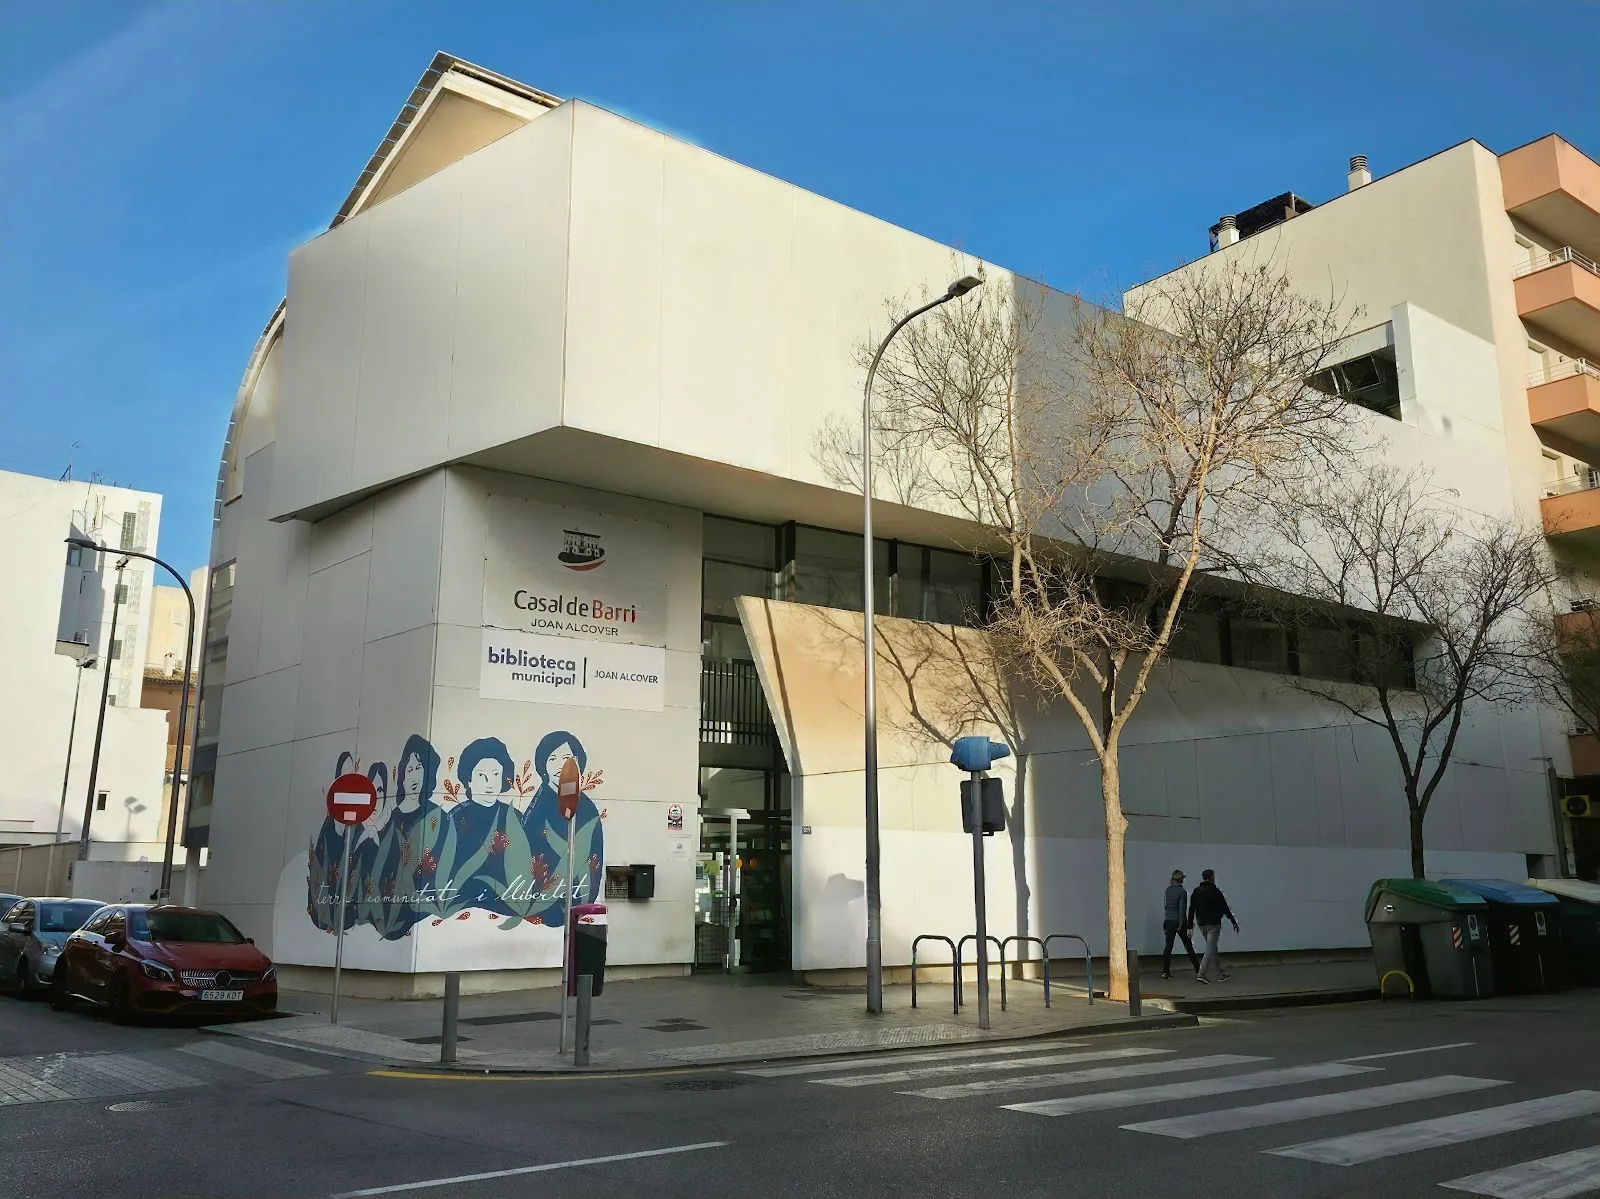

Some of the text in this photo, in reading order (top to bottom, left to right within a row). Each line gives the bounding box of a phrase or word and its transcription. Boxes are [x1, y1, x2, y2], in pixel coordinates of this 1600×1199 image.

[513, 589, 637, 624] Casal de Barri
[531, 618, 619, 637] JOAN ALCOVER
[488, 646, 576, 672] biblioteca
[511, 671, 576, 688] municipal
[594, 669, 659, 684] JOAN ALCOVER
[367, 878, 461, 905] comunitat
[475, 888, 488, 902] i
